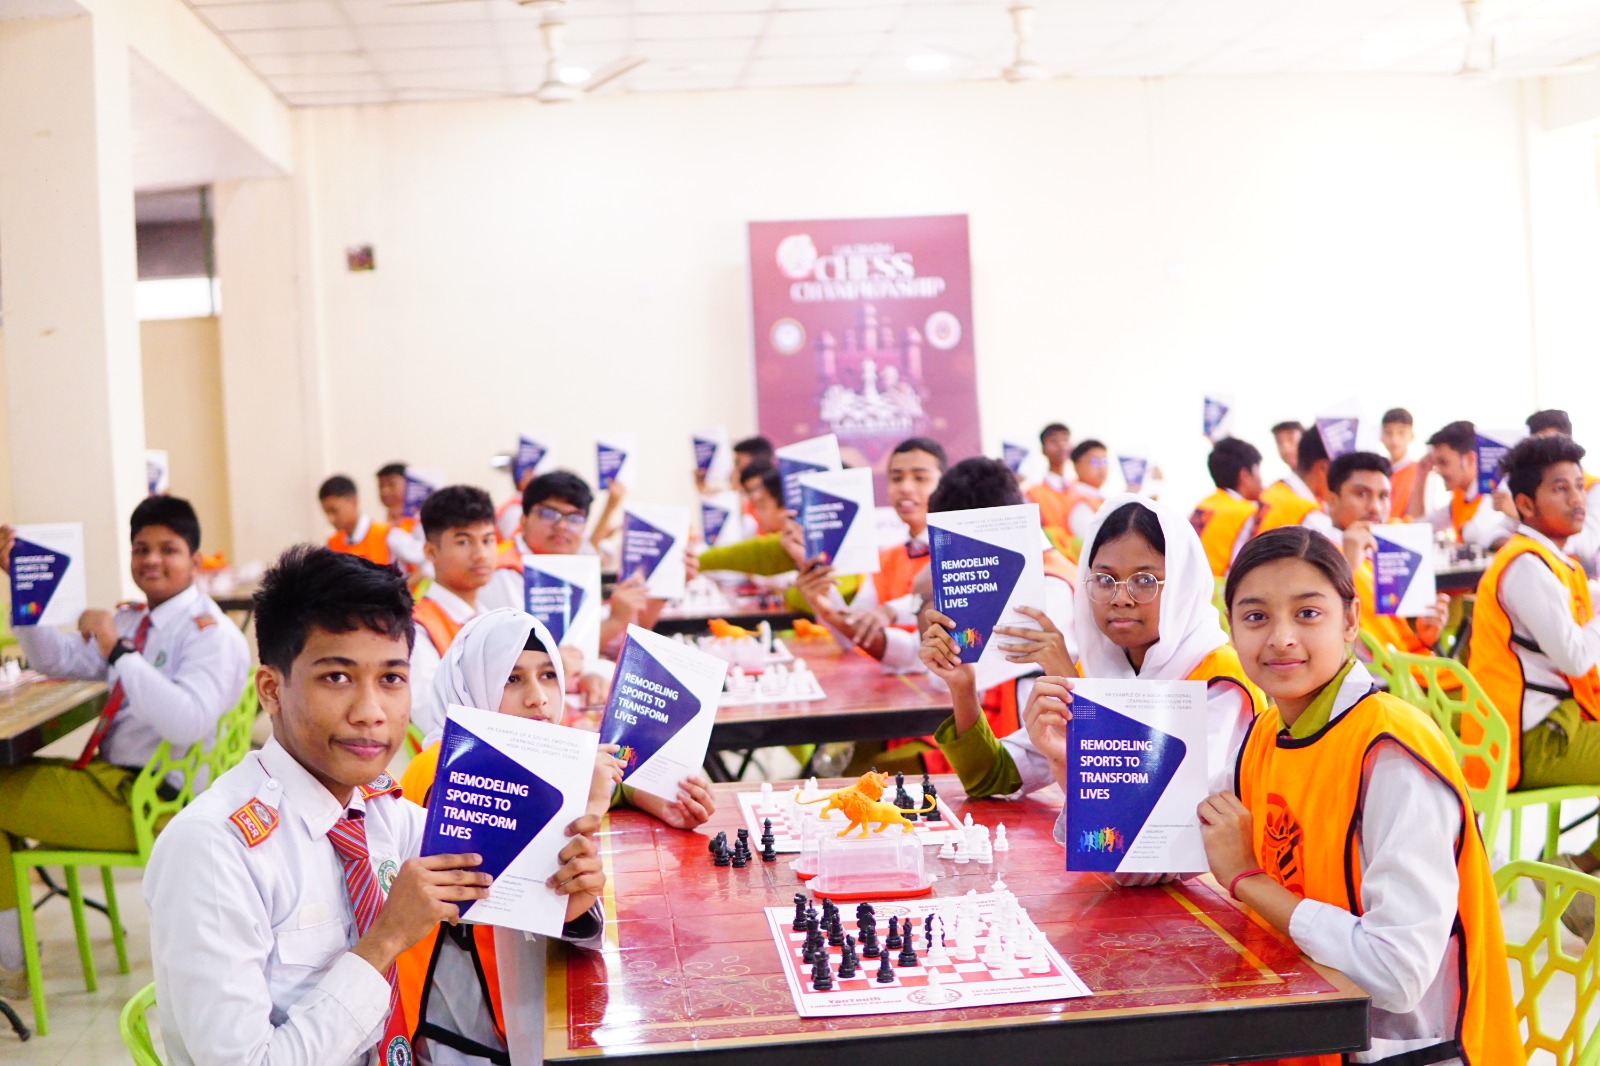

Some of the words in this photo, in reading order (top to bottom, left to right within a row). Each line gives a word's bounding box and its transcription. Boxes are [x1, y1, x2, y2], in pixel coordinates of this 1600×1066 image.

[942, 556, 999, 570] REMODELING
[942, 572, 976, 583] SPORTS
[977, 570, 990, 580] TO
[943, 582, 998, 596] TRANSFORM
[944, 598, 968, 609] LIVES
[624, 672, 679, 701] REMODELING
[621, 685, 653, 704] SPORTS
[654, 696, 666, 709] TO
[614, 709, 638, 726] LIVES
[618, 697, 669, 724] TRANSFORM
[1080, 740, 1153, 752] REMODELING
[1080, 756, 1122, 768] SPORTS
[1124, 756, 1140, 768] TO
[449, 771, 529, 798] REMODELING
[1080, 772, 1149, 784] TRANSFORM
[446, 788, 492, 808] SPORTS
[494, 798, 512, 812] TO
[1080, 788, 1110, 800] LIVES
[238, 812, 260, 838] LSCR
[443, 806, 517, 832] TRANSFORM
[439, 824, 472, 840] LIVES
